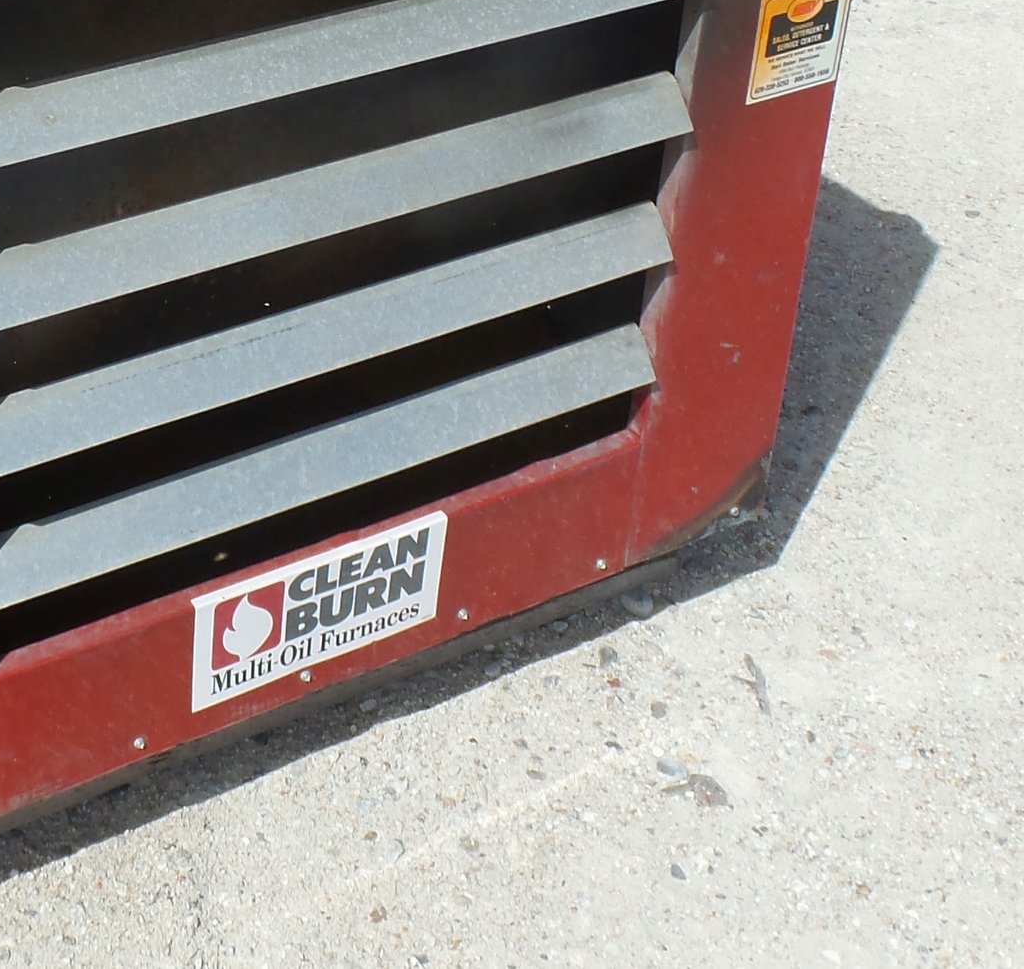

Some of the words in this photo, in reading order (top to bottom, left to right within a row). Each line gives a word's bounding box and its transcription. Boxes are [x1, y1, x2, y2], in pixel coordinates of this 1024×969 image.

[776, 41, 800, 52] SERVICE
[800, 34, 822, 46] CENTER
[284, 559, 426, 643] BURN
[287, 527, 430, 602] CLEAN
[210, 637, 313, 695] Multi-Oil
[318, 602, 421, 653] Furnaces
